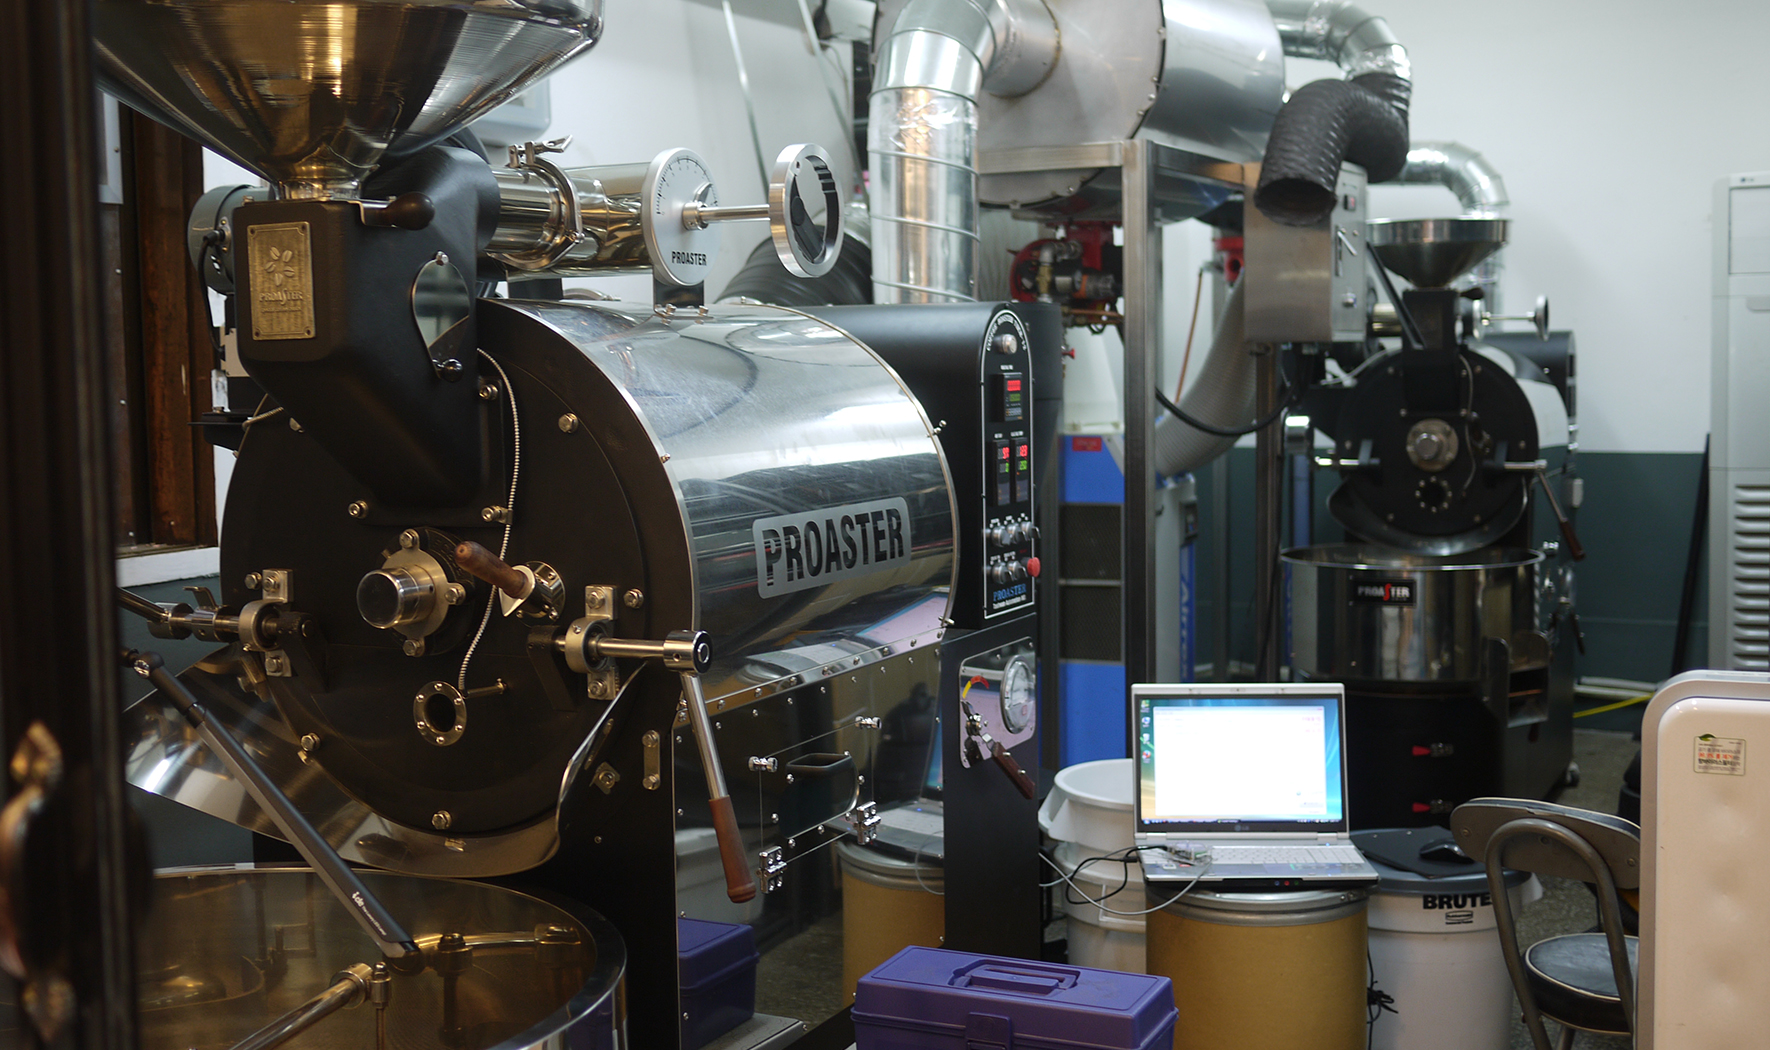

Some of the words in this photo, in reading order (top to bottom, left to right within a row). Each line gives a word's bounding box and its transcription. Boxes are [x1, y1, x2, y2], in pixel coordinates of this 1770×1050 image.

[671, 251, 707, 266] PROASTER
[762, 508, 904, 587] PROASTER
[993, 584, 1026, 601] PROASTER
[1358, 583, 1410, 601] PROASTER
[1423, 891, 1493, 910] BRUTE
